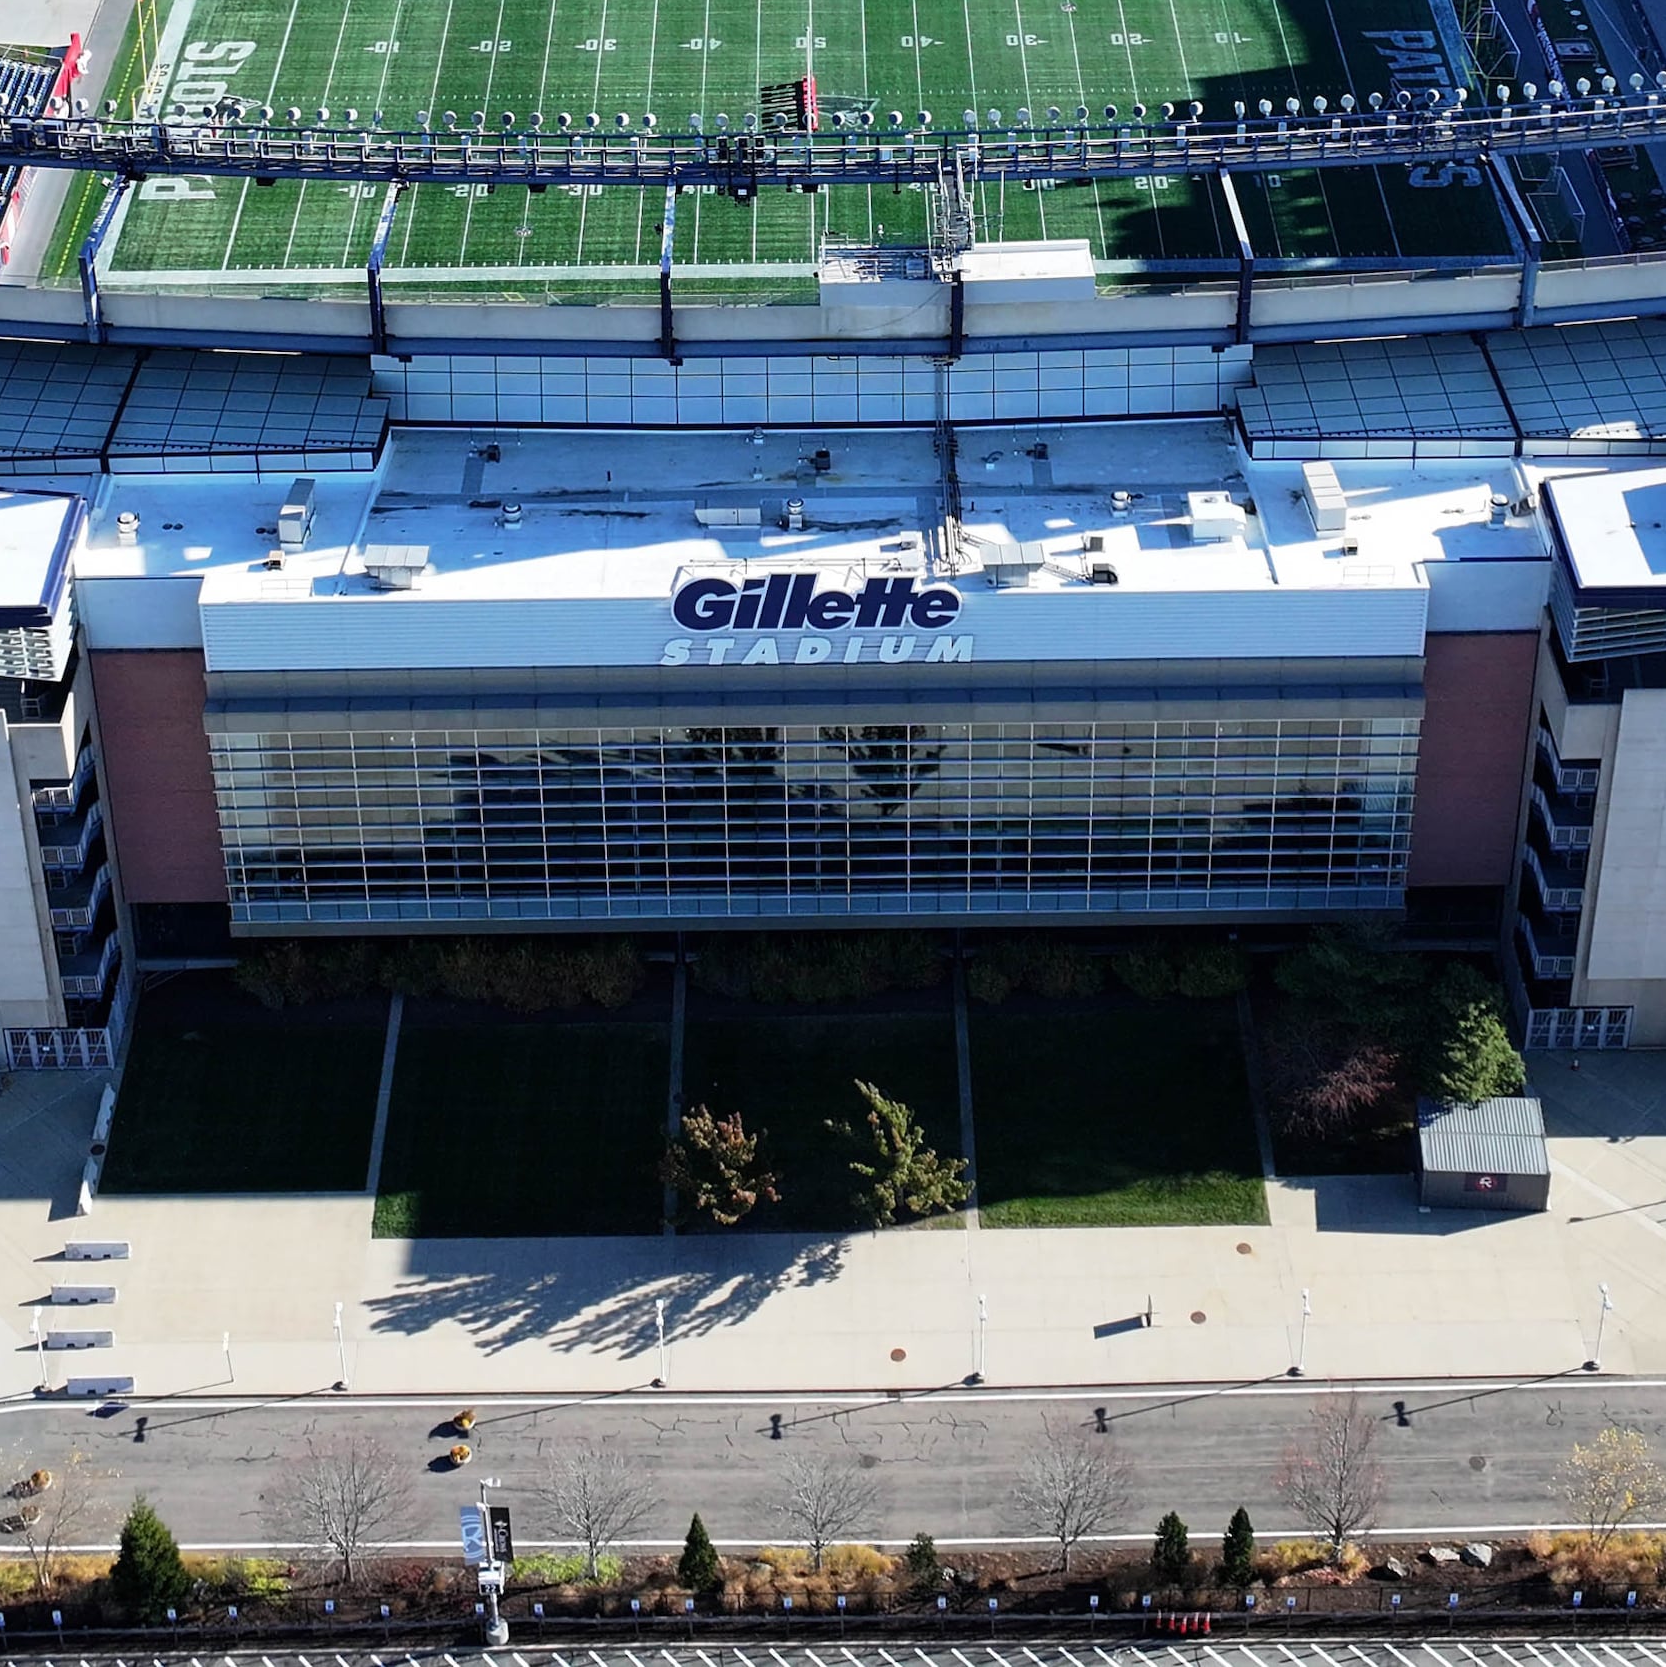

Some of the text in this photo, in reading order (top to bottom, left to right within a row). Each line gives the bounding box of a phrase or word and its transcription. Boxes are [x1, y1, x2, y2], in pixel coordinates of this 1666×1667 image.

[480, 39, 511, 52] 20
[585, 38, 617, 51] 30
[690, 37, 722, 50] 40
[796, 36, 827, 49] 50
[901, 35, 932, 48] 40
[1005, 34, 1037, 47] 30
[1110, 33, 1143, 46] 20
[1361, 29, 1484, 188] PATRS
[139, 41, 257, 201] PIOTS
[568, 182, 603, 197] 30
[1134, 176, 1169, 190] 20
[348, 184, 376, 199] 10
[455, 183, 490, 198] 20
[673, 573, 961, 632] Gillette
[660, 635, 974, 666] STADIUM
